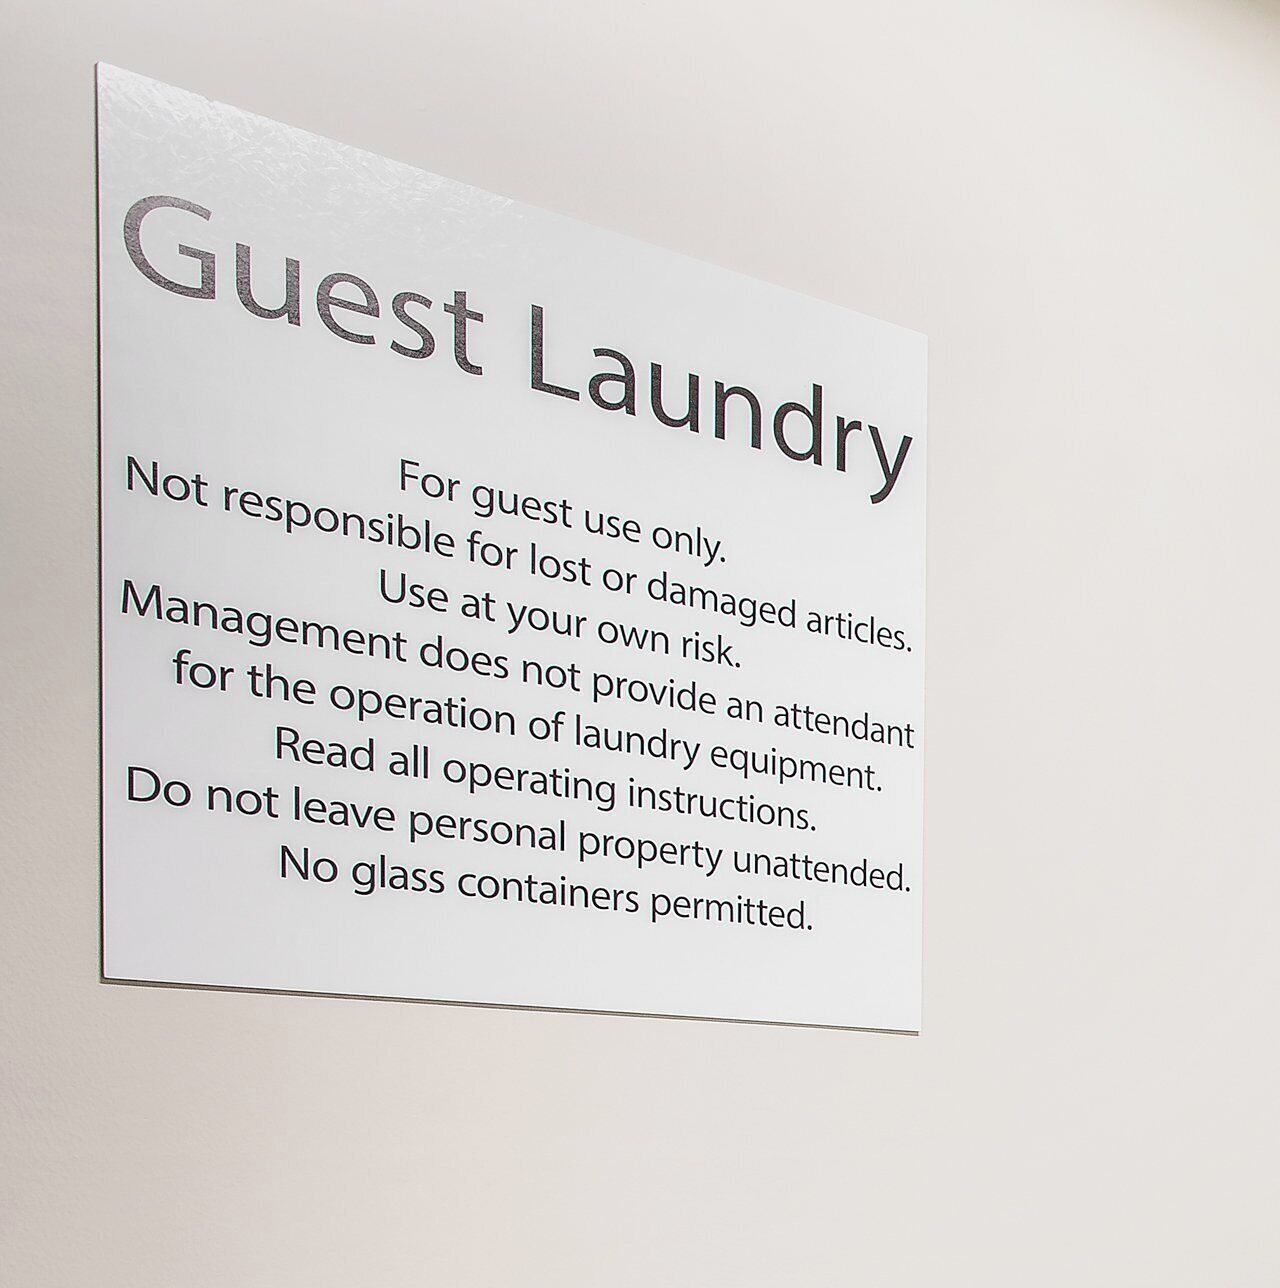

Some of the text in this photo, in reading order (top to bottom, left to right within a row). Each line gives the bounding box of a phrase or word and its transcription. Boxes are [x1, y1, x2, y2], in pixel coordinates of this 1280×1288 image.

[123, 196, 912, 504] Guest Laundry
[127, 456, 911, 652] Not responsible for lost or damaged articles.
[401, 459, 725, 567] For guest use only.
[122, 579, 914, 748] Management does not provide an attendant
[380, 569, 740, 668] Use at your own risk.
[172, 649, 881, 791] for the operation of laundry equipment.
[277, 726, 815, 831] Read all operating instructions.
[128, 766, 910, 892] Do not leave personal property unattended.
[281, 845, 812, 930] No glass containers permitted.
